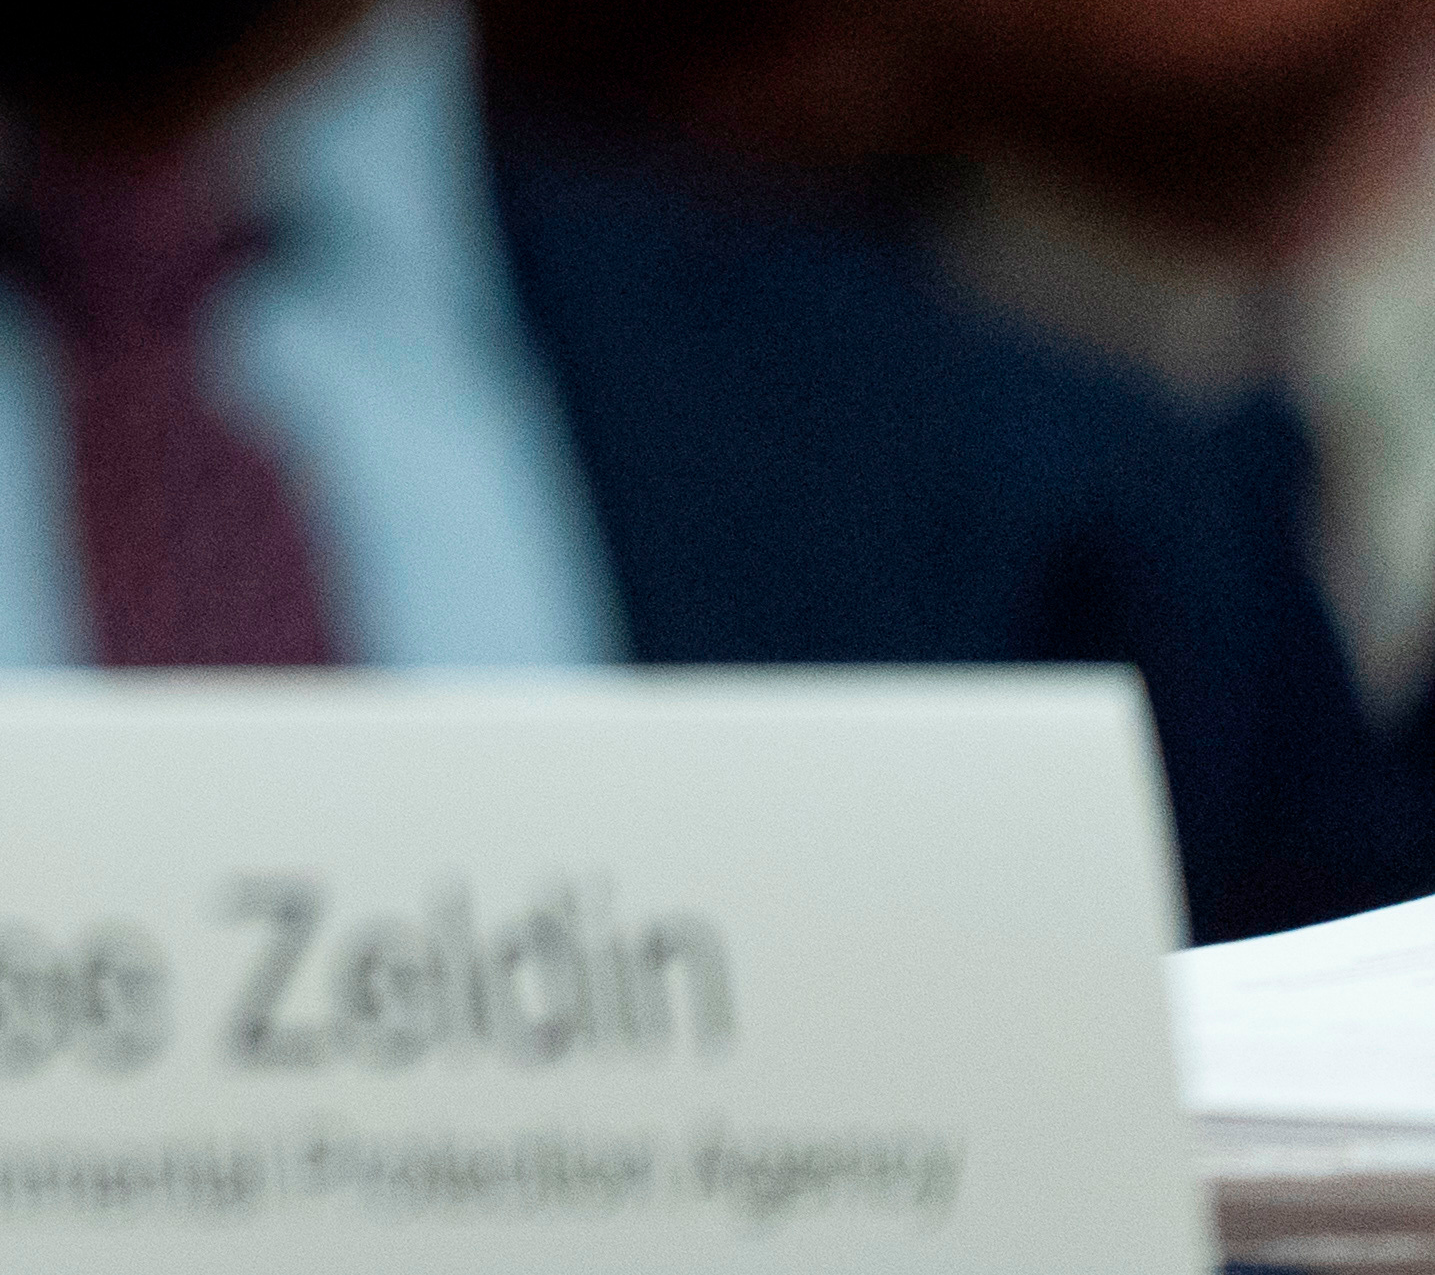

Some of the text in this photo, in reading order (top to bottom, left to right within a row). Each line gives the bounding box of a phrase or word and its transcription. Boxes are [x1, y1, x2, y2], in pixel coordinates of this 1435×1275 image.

[214, 870, 738, 1072] Zeldin
[288, 1120, 662, 1212] Protection
[682, 1112, 966, 1224] Agency
